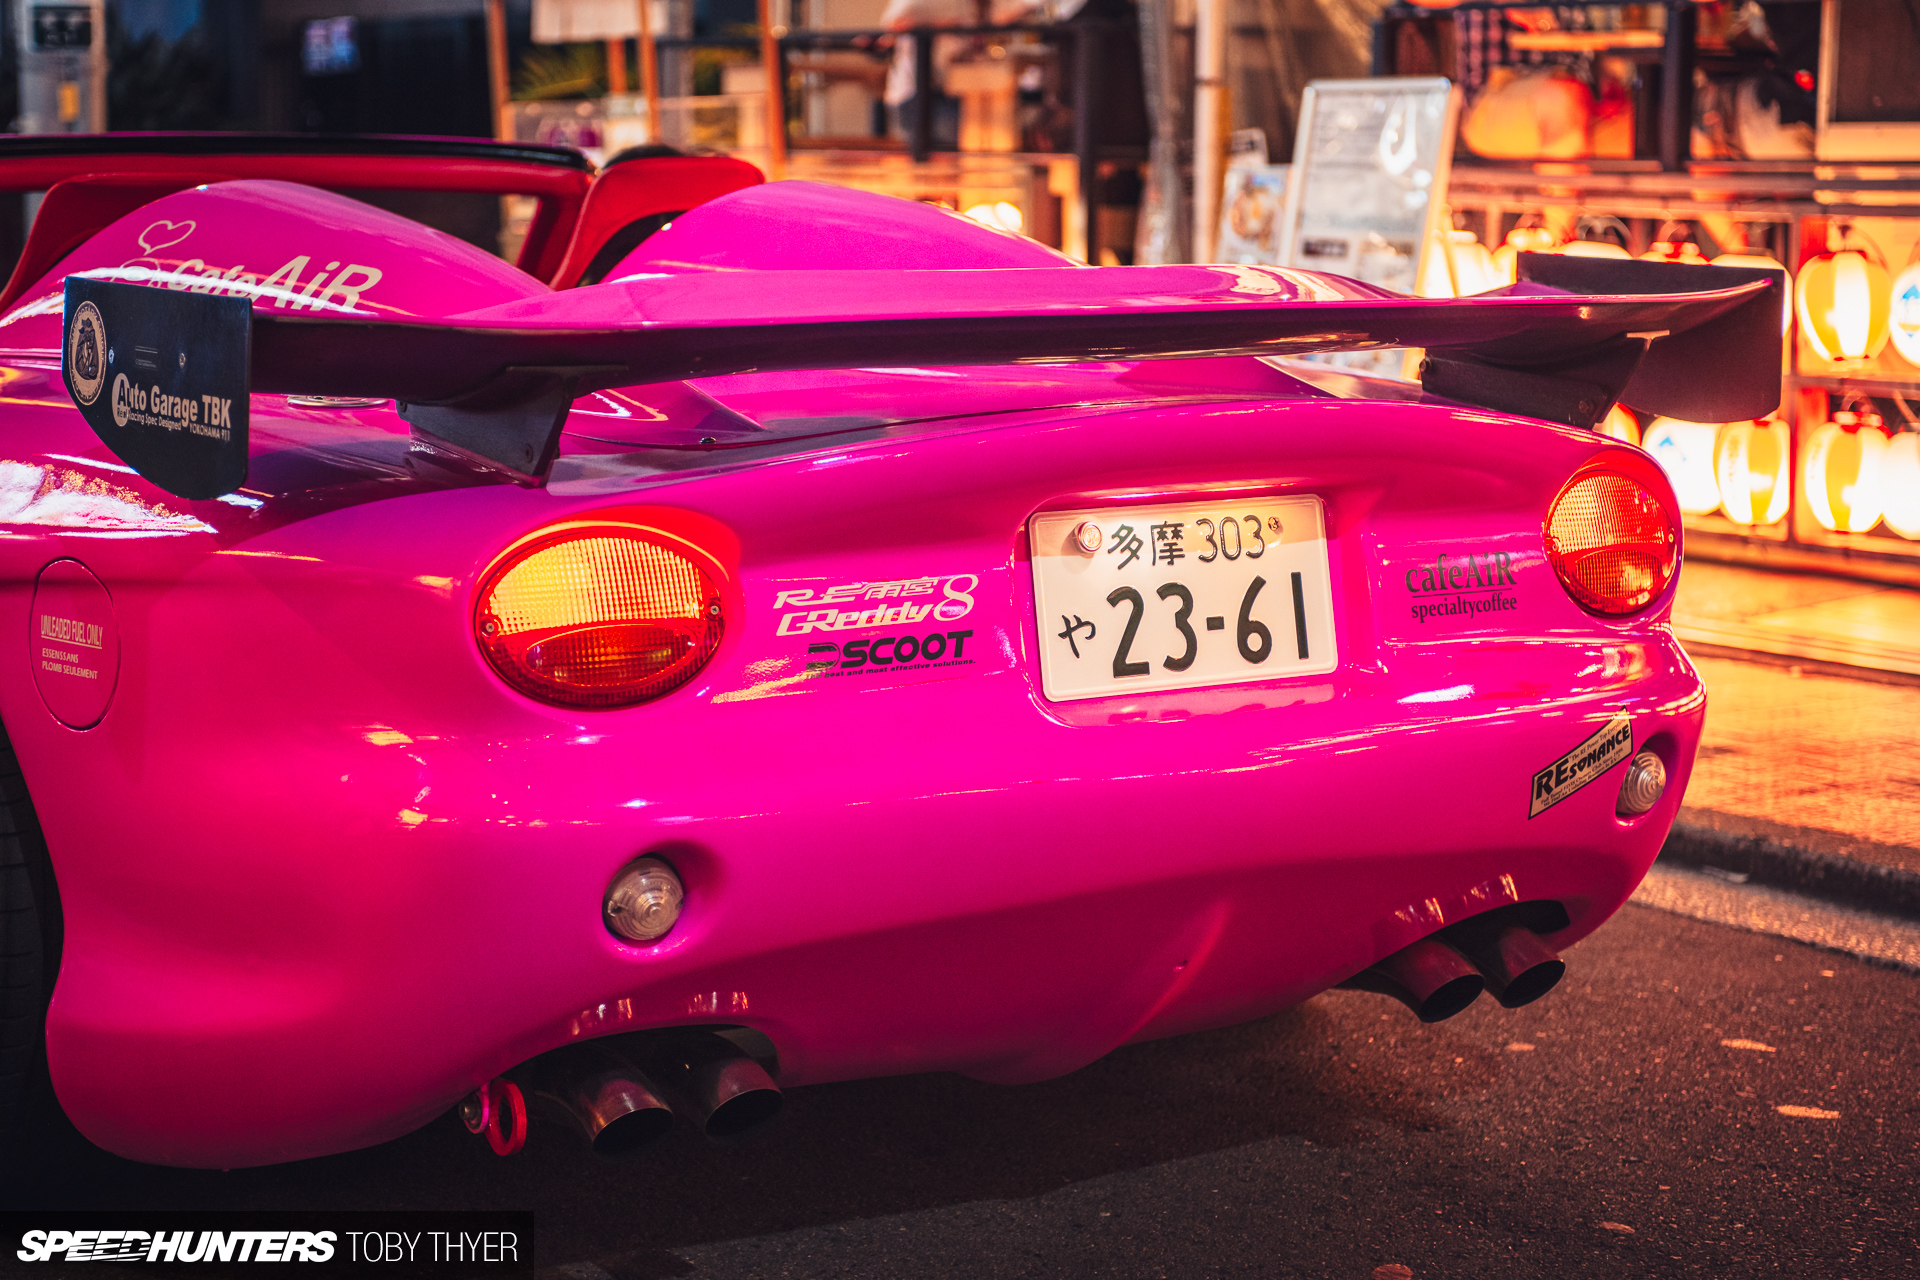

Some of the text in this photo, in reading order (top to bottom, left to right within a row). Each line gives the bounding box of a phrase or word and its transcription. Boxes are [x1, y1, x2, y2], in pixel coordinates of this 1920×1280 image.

[117, 379, 232, 429] Auto Garage TBK
[188, 422, 221, 440] YOKOHAMA
[1107, 514, 1265, 570] 多摩 303
[1405, 551, 1517, 593] cafeAiR
[1411, 592, 1517, 623] specialtycoffee
[41, 615, 103, 647] UNLEADED FUEL ONLY
[1058, 571, 1310, 679] や 23-61
[42, 661, 98, 680] PLOMB SEULEMENT
[824, 670, 845, 679] best
[846, 669, 863, 677] and
[866, 667, 888, 675] most
[890, 662, 930, 672] effective
[933, 659, 976, 669] solutions.
